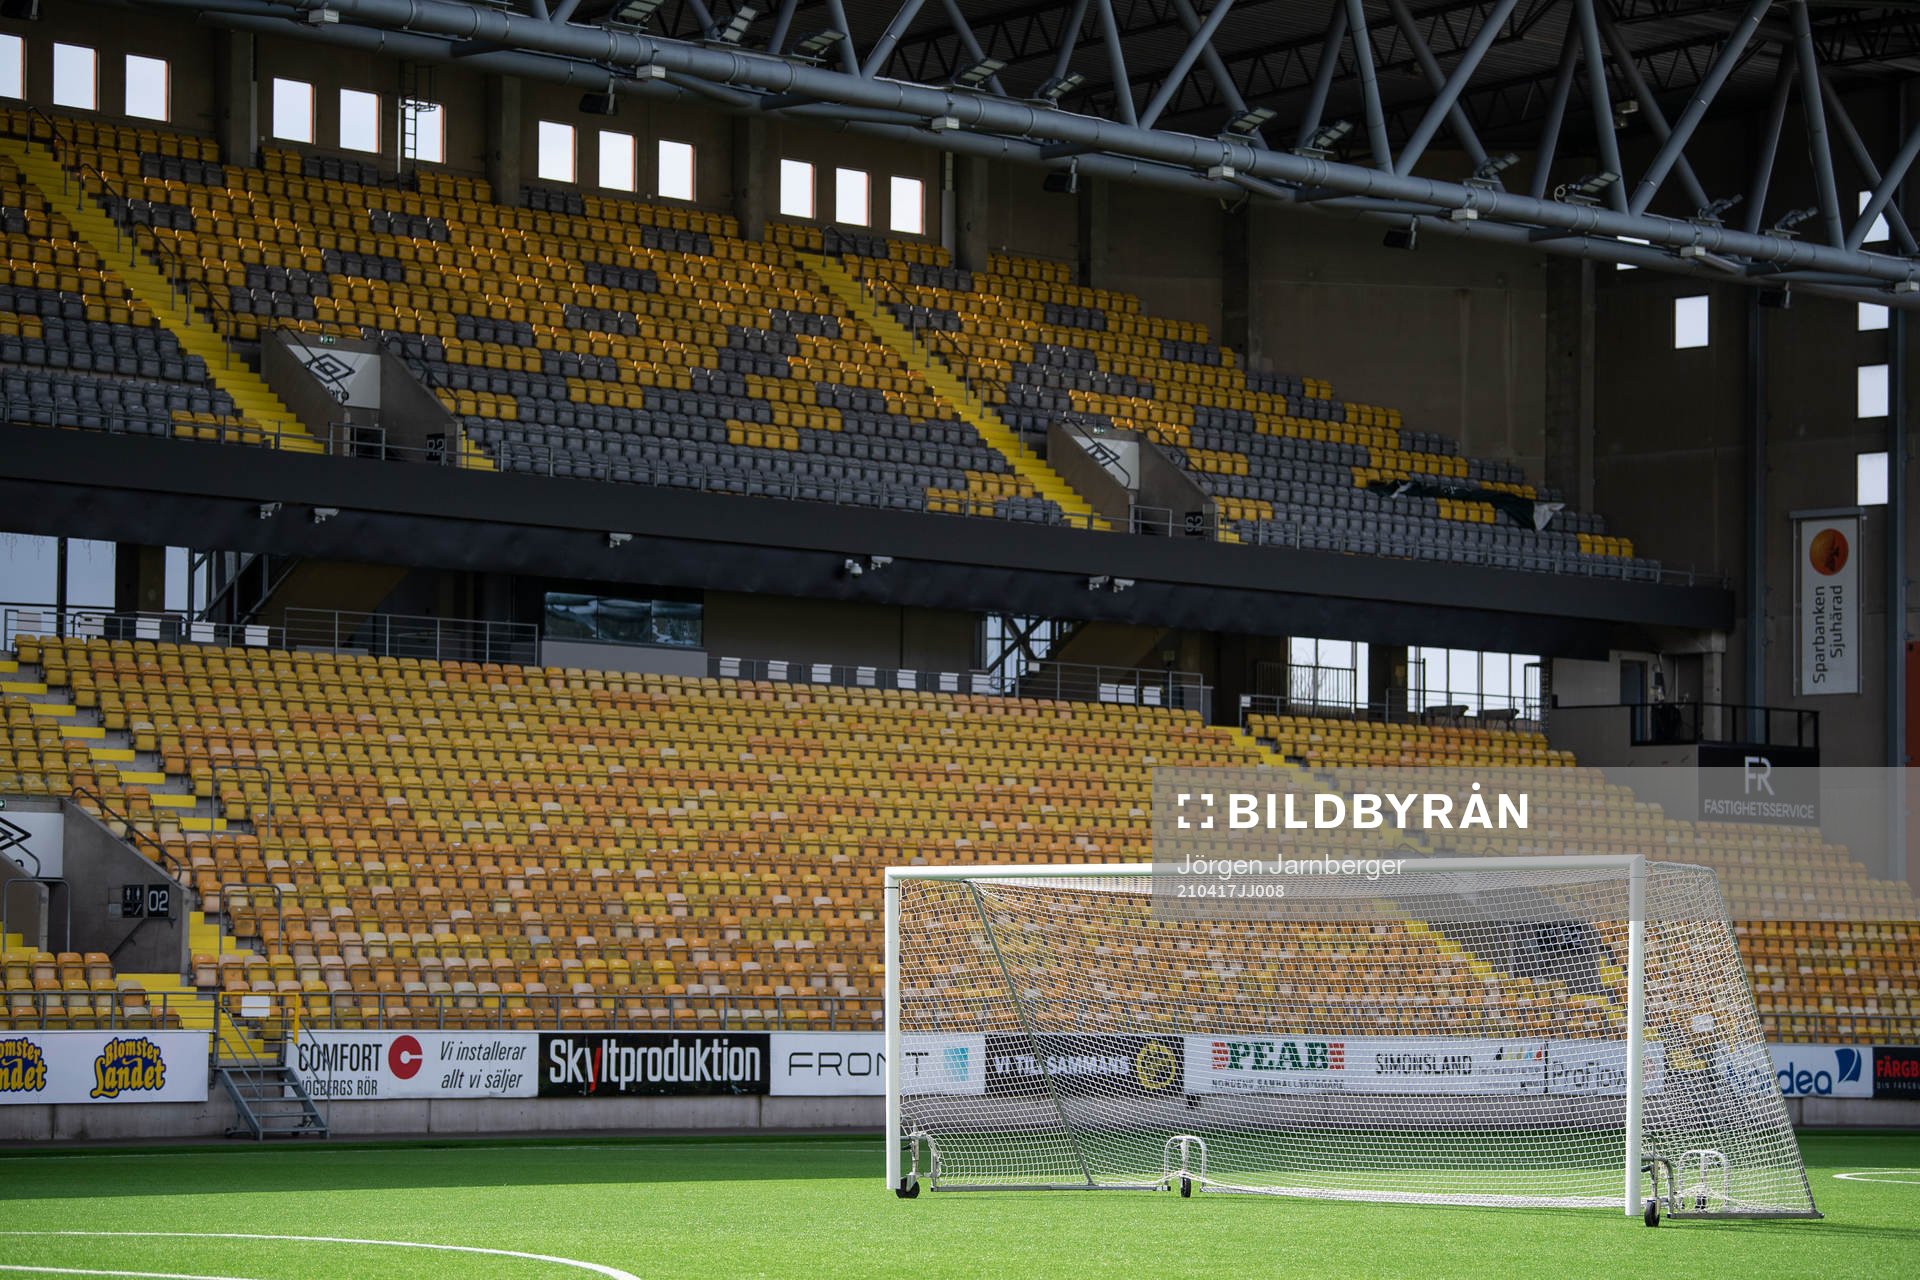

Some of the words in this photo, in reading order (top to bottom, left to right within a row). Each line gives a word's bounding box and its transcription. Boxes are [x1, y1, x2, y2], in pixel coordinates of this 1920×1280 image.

[1812, 585, 1826, 685] Sparbanken
[1829, 584, 1844, 658] Sjuhärad
[1703, 798, 1815, 819] FASTIGHETSSERVICE
[148, 889, 169, 911] 02
[103, 1038, 161, 1066] Blomster
[299, 1043, 382, 1072] COMFORT
[440, 1041, 454, 1061] Vi
[456, 1040, 527, 1061] installerar
[1226, 1041, 1329, 1071] PEAB
[1375, 1052, 1473, 1076] SIMONSLAND
[91, 1056, 165, 1098] Landet
[550, 1038, 761, 1092] Skyltproduktion
[358, 1076, 378, 1096] RÖR
[441, 1069, 465, 1089] allt
[469, 1071, 481, 1089] vi
[484, 1069, 523, 1093] säljer
